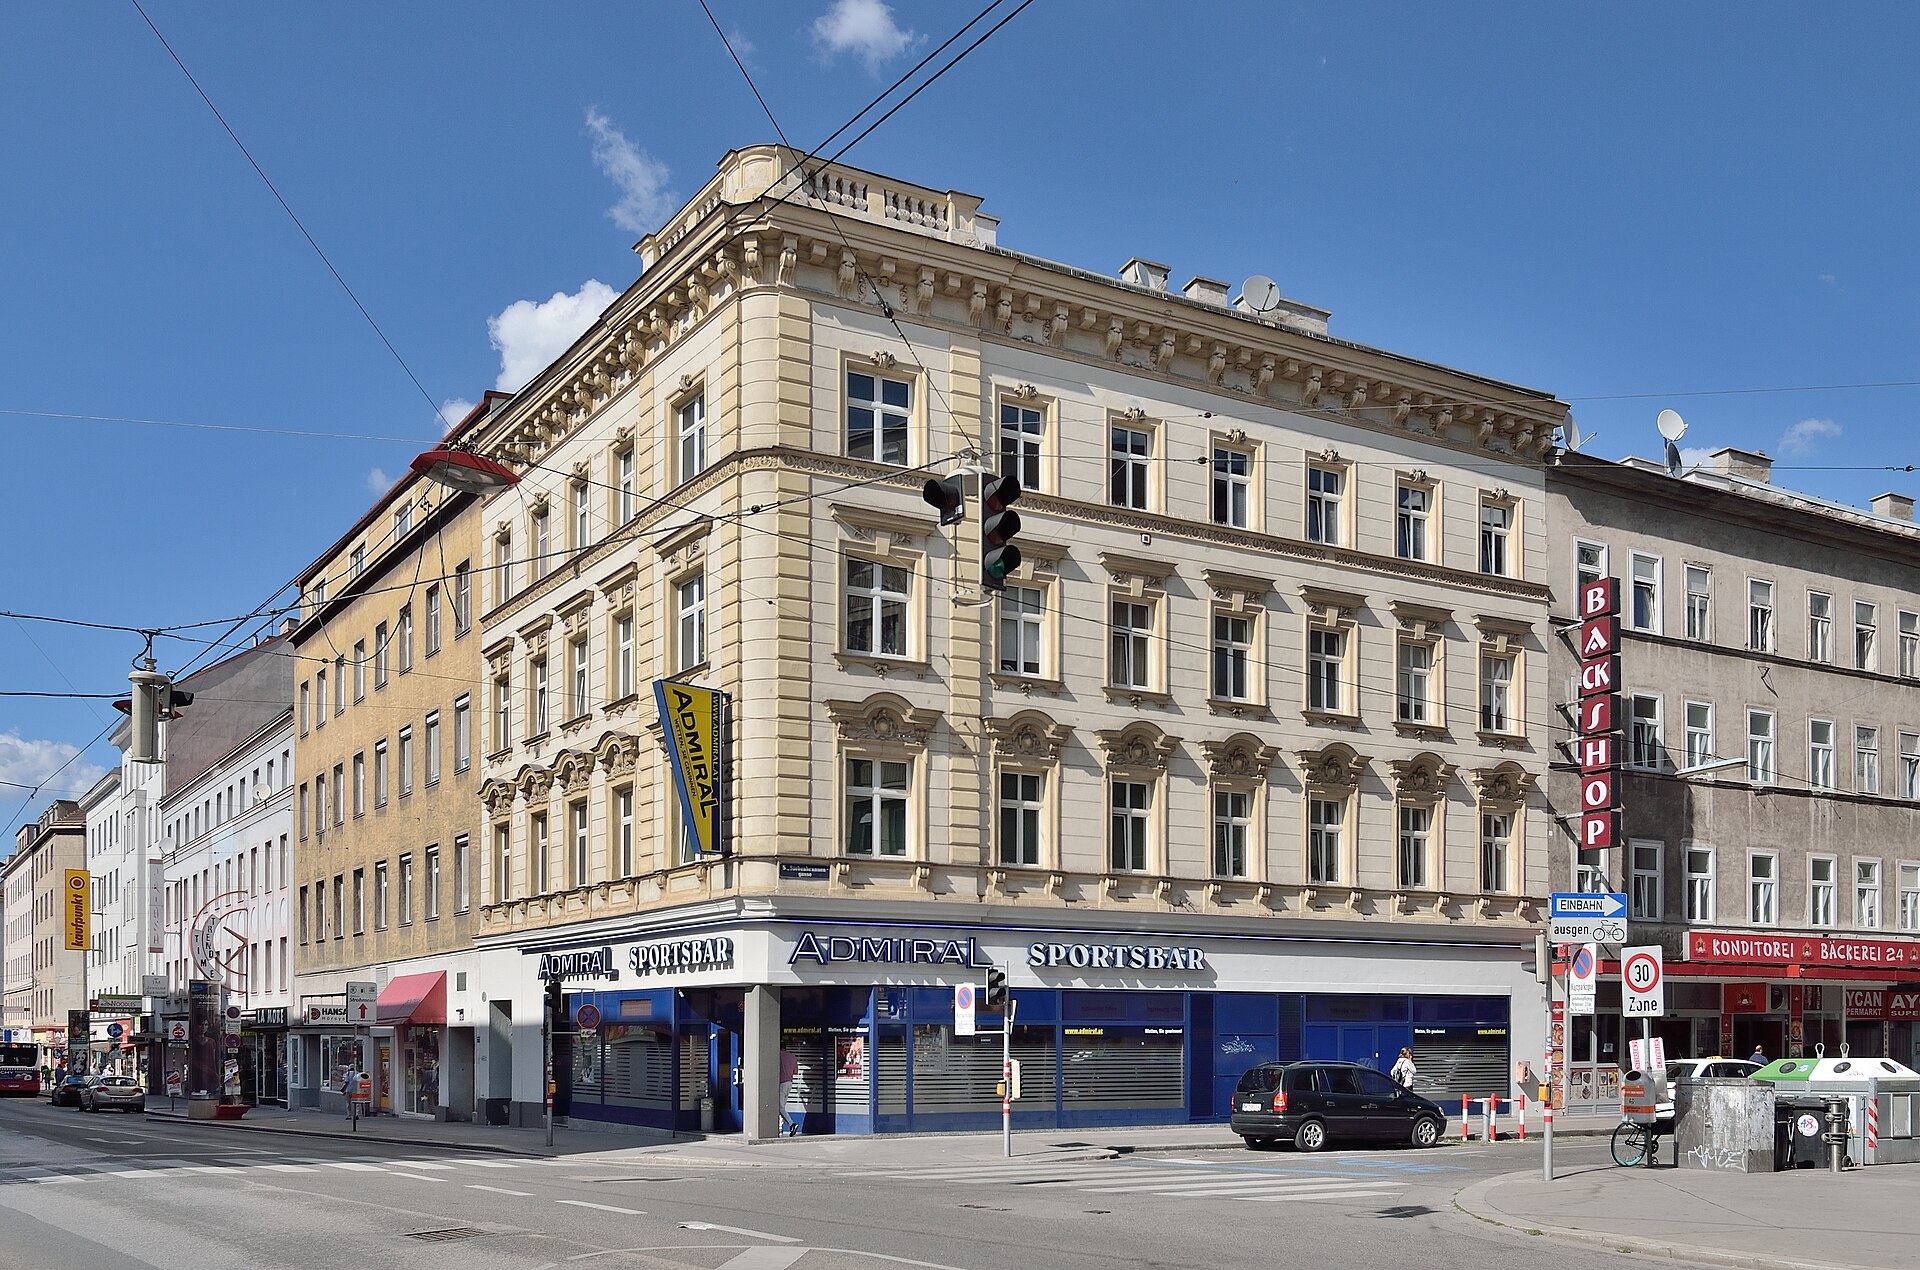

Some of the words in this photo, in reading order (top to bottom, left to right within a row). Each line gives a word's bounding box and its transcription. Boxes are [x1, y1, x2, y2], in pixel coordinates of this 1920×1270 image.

[1582, 586, 1610, 845] BACKSHOP
[672, 688, 719, 818] ADMIRAL
[712, 695, 720, 783] WWW.ADMIRAL.AT
[674, 717, 683, 749] WETTEN,
[684, 760, 697, 799] GEWINNEN.
[70, 893, 86, 947] kaufpunkt
[1560, 899, 1603, 910] EINBAHN
[204, 917, 216, 958] TREND
[1554, 925, 1592, 938] ausgen.
[194, 934, 214, 978] TIME
[538, 947, 613, 980] ADMIRAL
[629, 937, 730, 970] SPORTSBAR
[788, 931, 990, 969] ADMIRAL
[1027, 942, 1205, 970] SPORTSBAR
[1712, 938, 1794, 958] KONDITOREI
[1820, 941, 1881, 962] BÄCKEREI
[1886, 947, 1904, 962] 24
[1634, 964, 1650, 982] 30
[1629, 996, 1658, 1012] Zone
[1846, 991, 1882, 1007] YCAN
[1846, 1008, 1882, 1016] PERMARKT
[1890, 994, 1920, 1009] AY
[1799, 1118, 1813, 1129] 48
